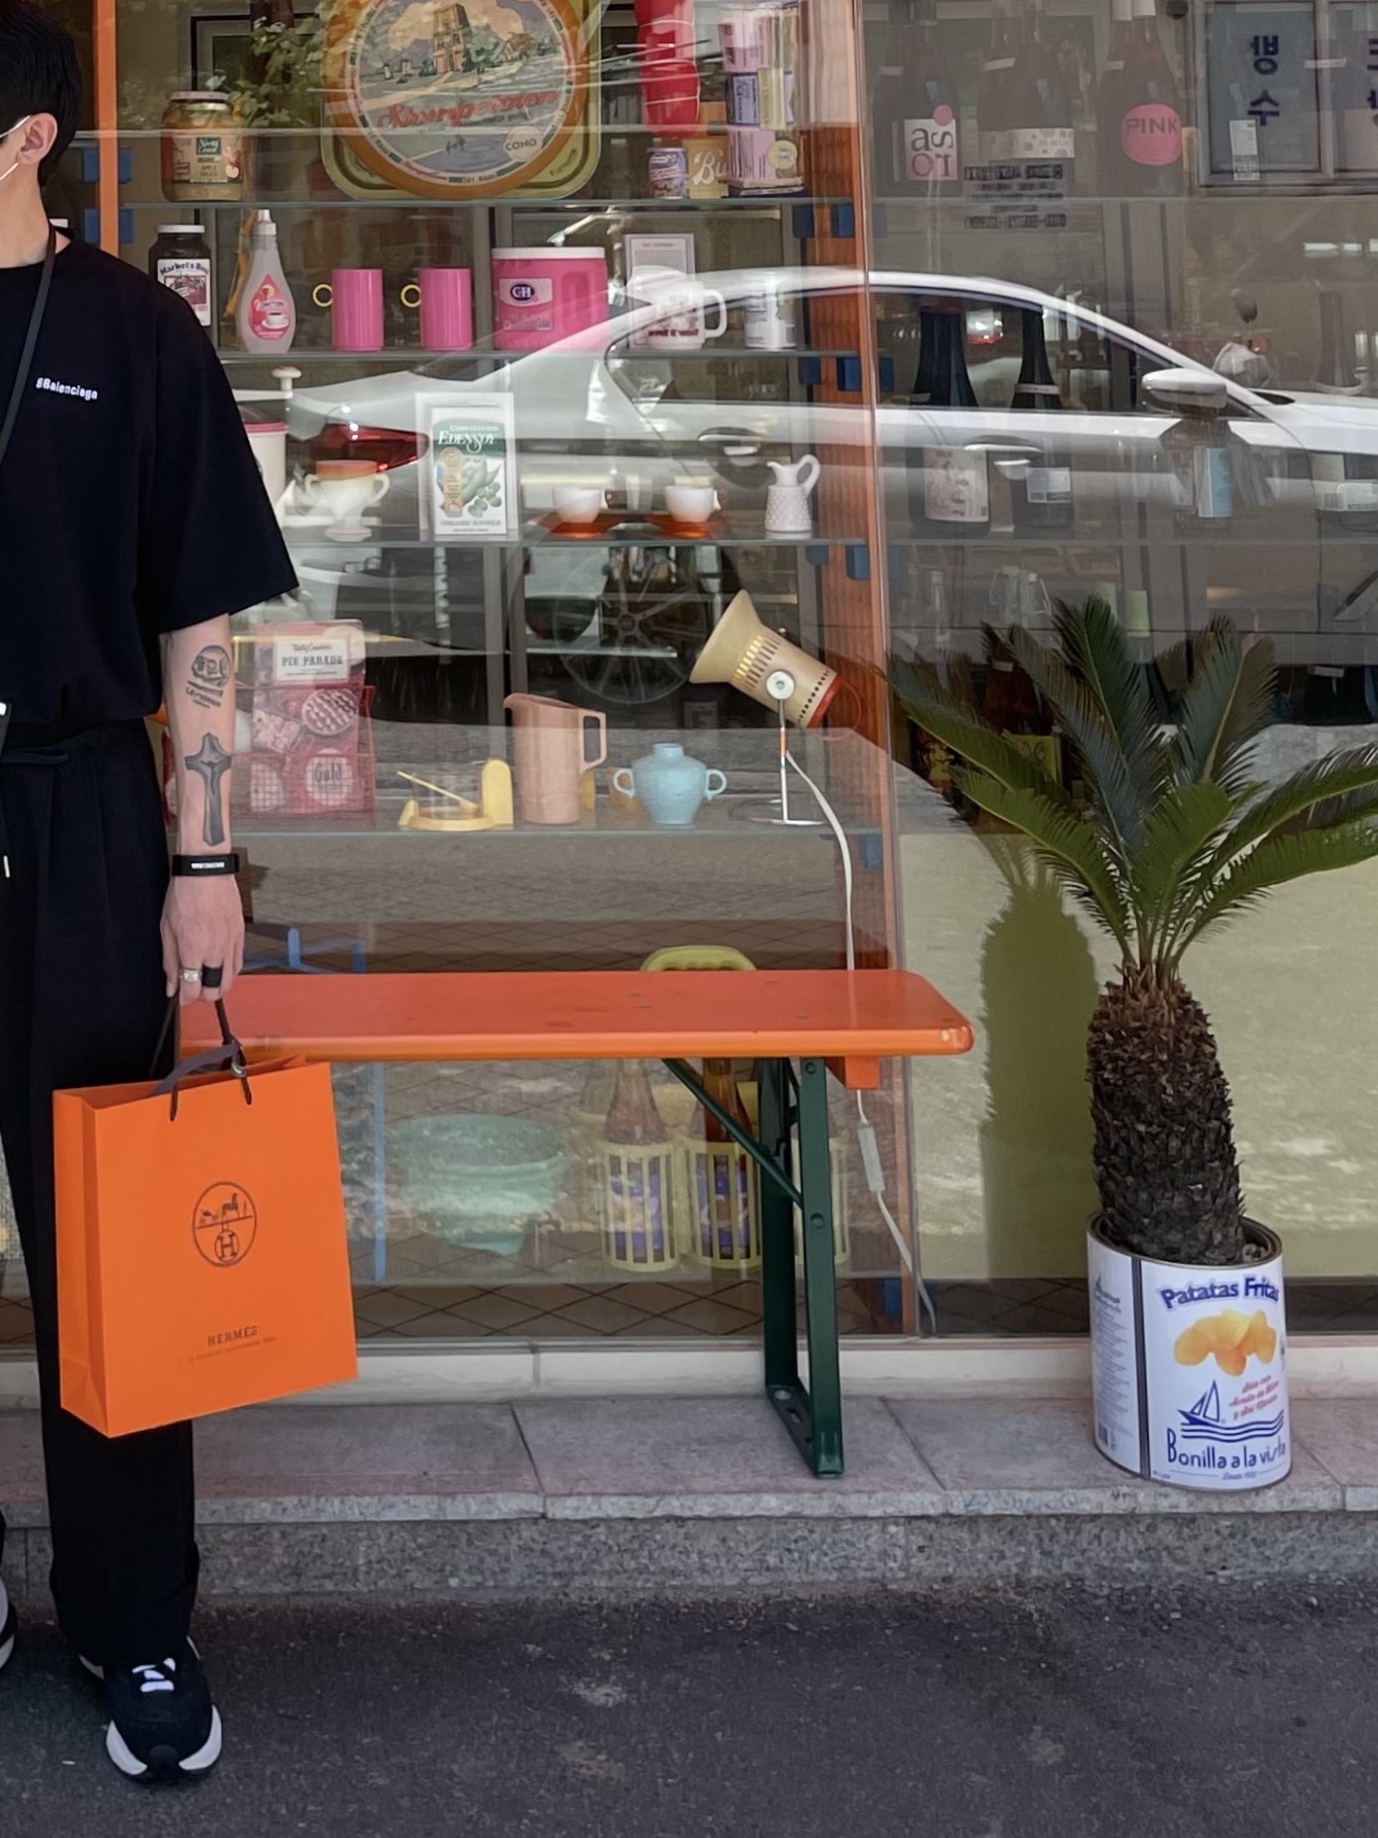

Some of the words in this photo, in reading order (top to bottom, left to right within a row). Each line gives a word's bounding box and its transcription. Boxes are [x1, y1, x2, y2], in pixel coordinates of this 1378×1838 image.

[1125, 116, 1180, 136] PINK
[505, 138, 538, 152] CONO
[281, 656, 300, 667] PIE
[303, 655, 343, 667] PARADE
[1160, 1280, 1239, 1310] Patatas
[1166, 1427, 1228, 1469] Bonilla
[1231, 1454, 1241, 1468] a
[1243, 1446, 1257, 1468] la
